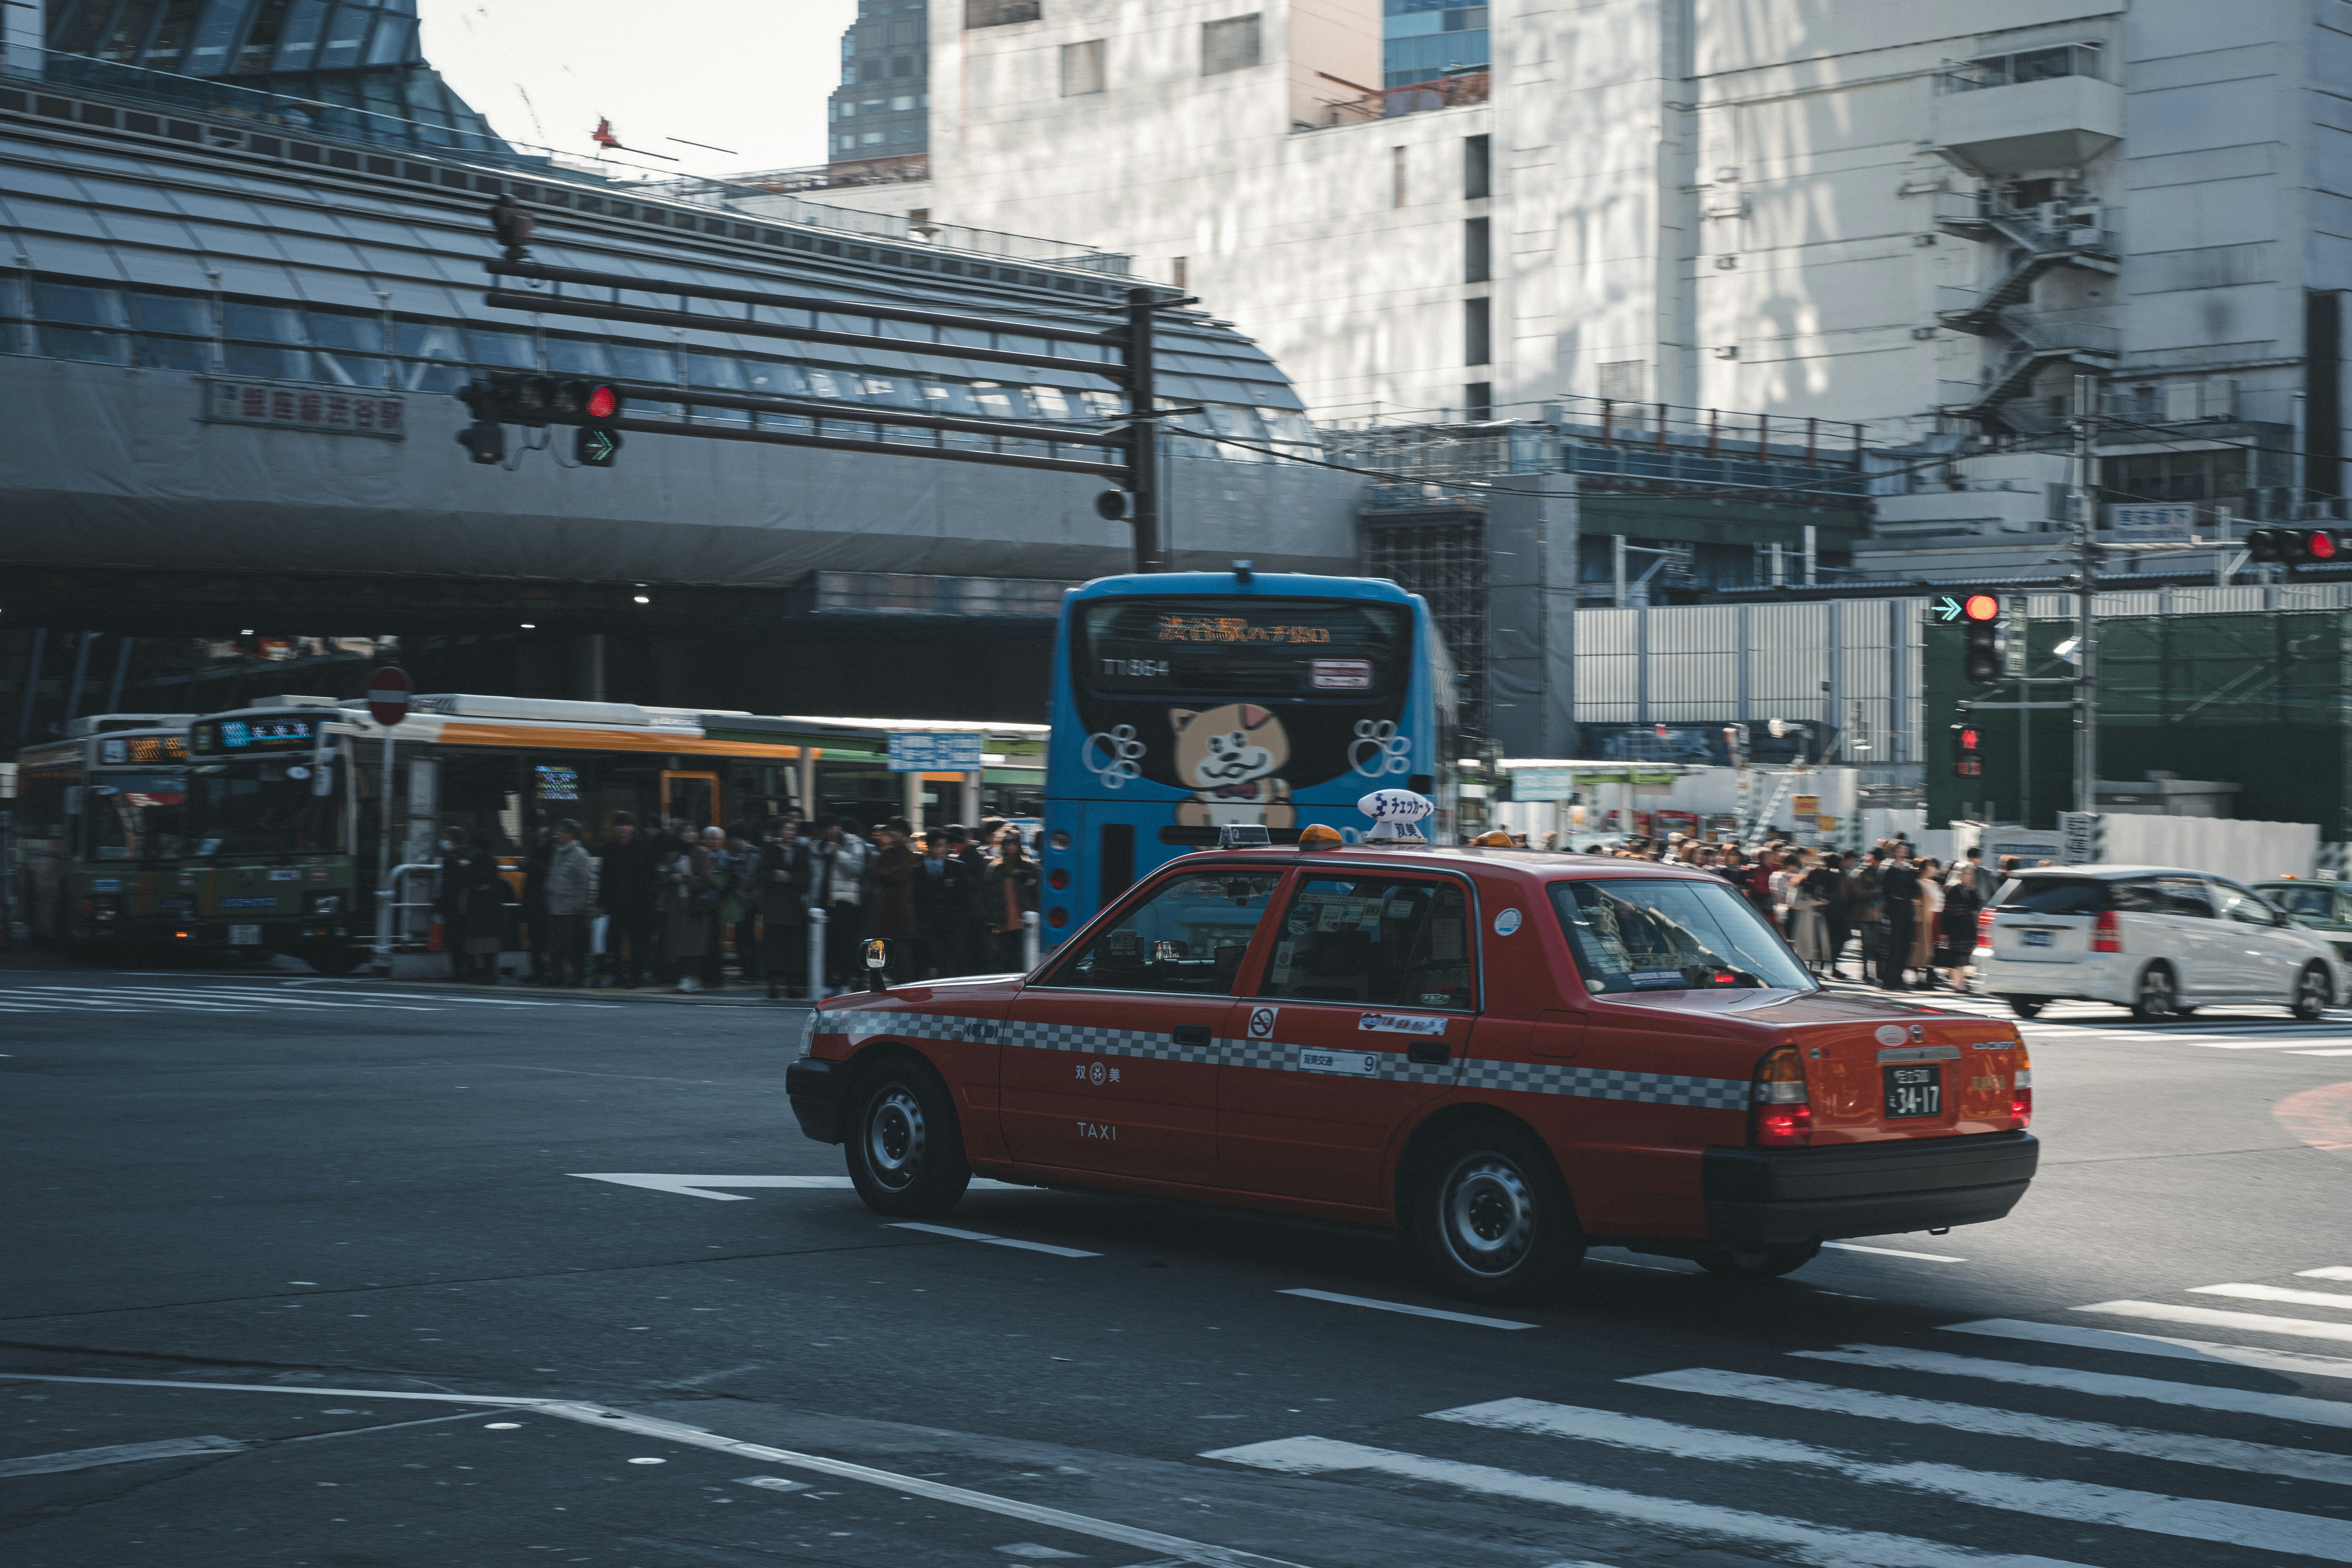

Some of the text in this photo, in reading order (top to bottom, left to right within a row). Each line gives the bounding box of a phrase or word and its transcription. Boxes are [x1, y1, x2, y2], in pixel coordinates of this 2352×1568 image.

[1392, 797, 1424, 815] チェッカー
[1394, 823, 1418, 838] 双美
[1364, 1056, 1374, 1071] 9
[1076, 1065, 1120, 1083] 双 美
[1896, 1086, 1939, 1113] 34-17
[1077, 1122, 1116, 1141] TAXI
